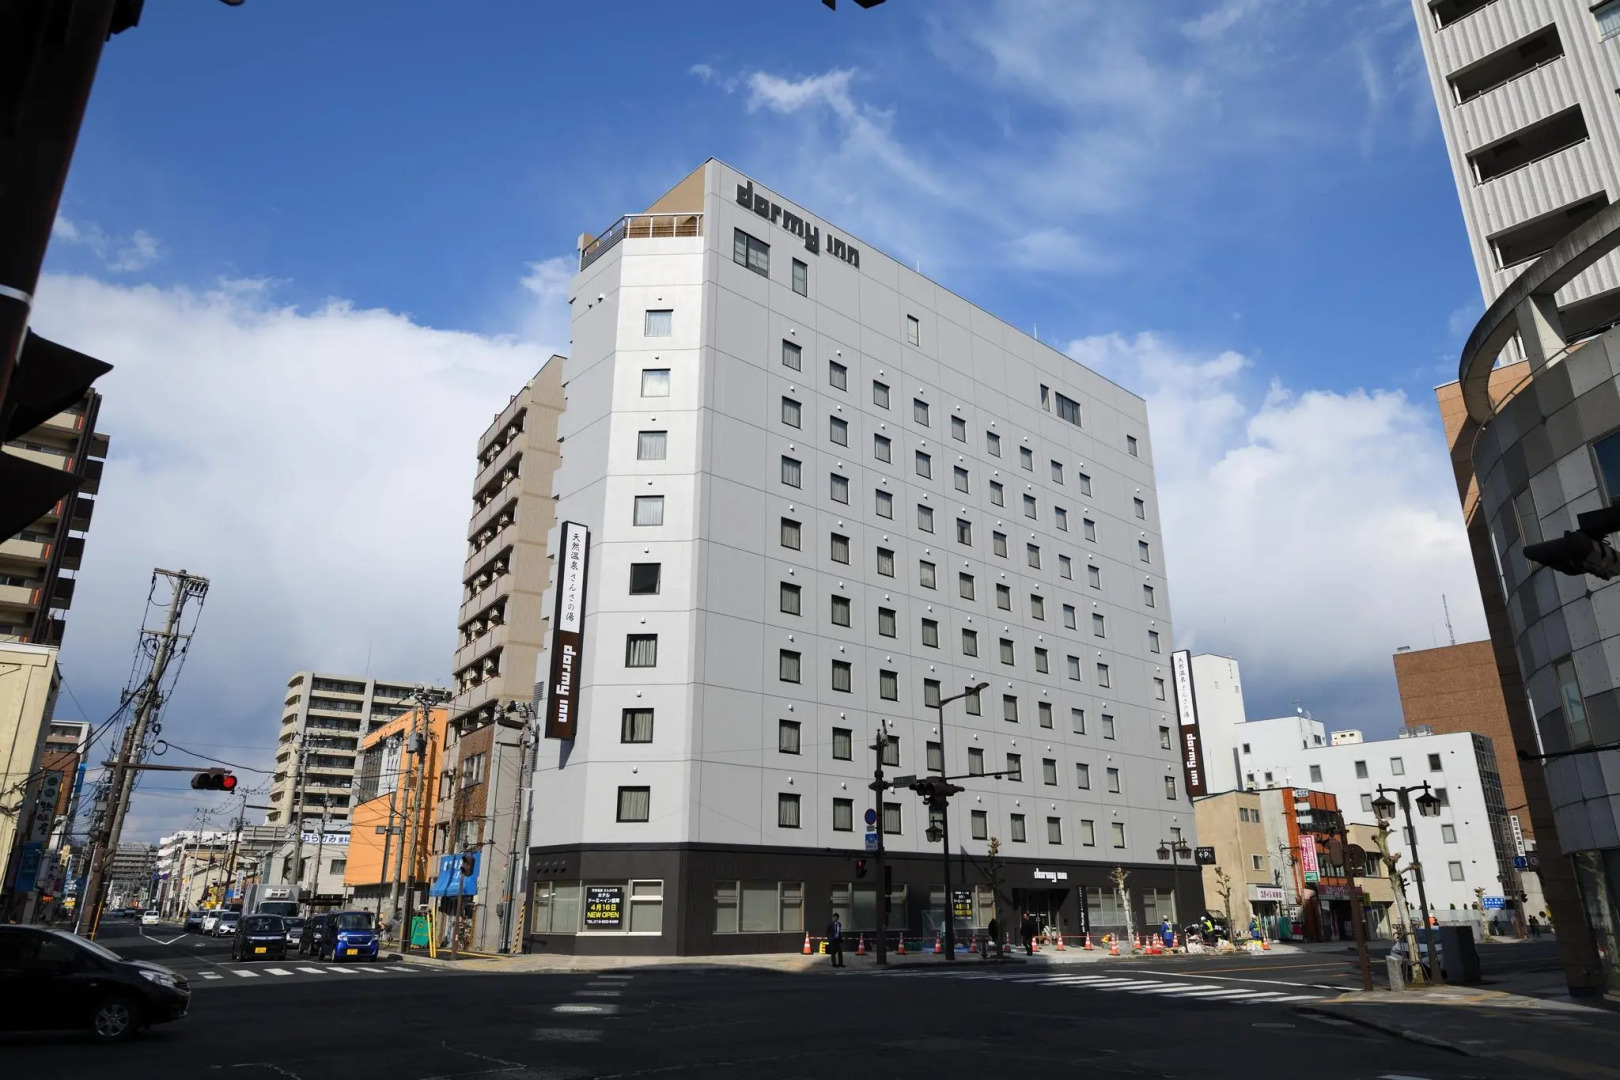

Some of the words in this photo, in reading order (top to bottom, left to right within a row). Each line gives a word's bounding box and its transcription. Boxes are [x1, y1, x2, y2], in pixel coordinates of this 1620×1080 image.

[736, 180, 820, 256] dormy
[826, 234, 860, 270] inn
[556, 644, 577, 696] dormy
[557, 701, 568, 723] inn
[1186, 733, 1197, 768] dormy
[1190, 770, 1199, 786] inn
